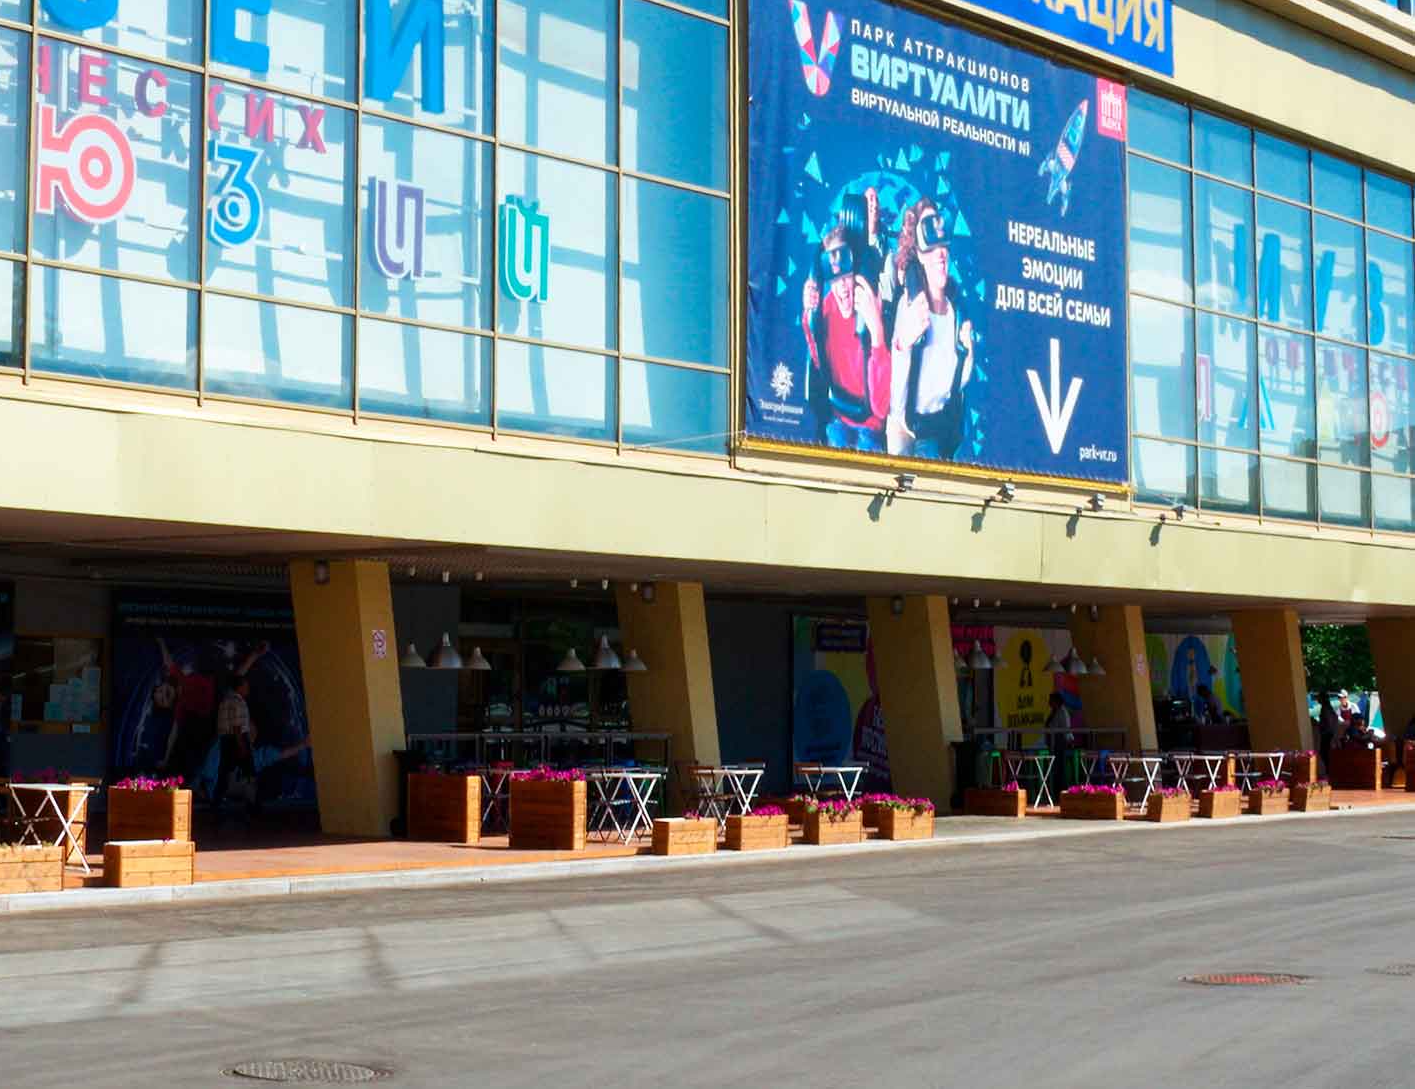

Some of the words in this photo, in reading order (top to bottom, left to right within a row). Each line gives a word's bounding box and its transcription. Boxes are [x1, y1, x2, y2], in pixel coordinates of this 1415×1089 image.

[851, 19, 895, 47] ПАРК
[904, 38, 1030, 93] АТТРАКЦИОНОВ
[851, 44, 1030, 131] ВИРТУАЛИТИ
[851, 88, 940, 129] ВИРТУАЛЬНОЙ
[943, 116, 1016, 152] РЕАЛЬНОСТИ
[1008, 221, 1095, 262] НЕРЕАЛЬНЫЕ
[1022, 257, 1083, 290] ЭМОЦИИ
[995, 284, 1025, 310] ДЛЯ
[1028, 291, 1063, 318] ВСЕЙ
[1066, 299, 1111, 328] СЕМЬИ
